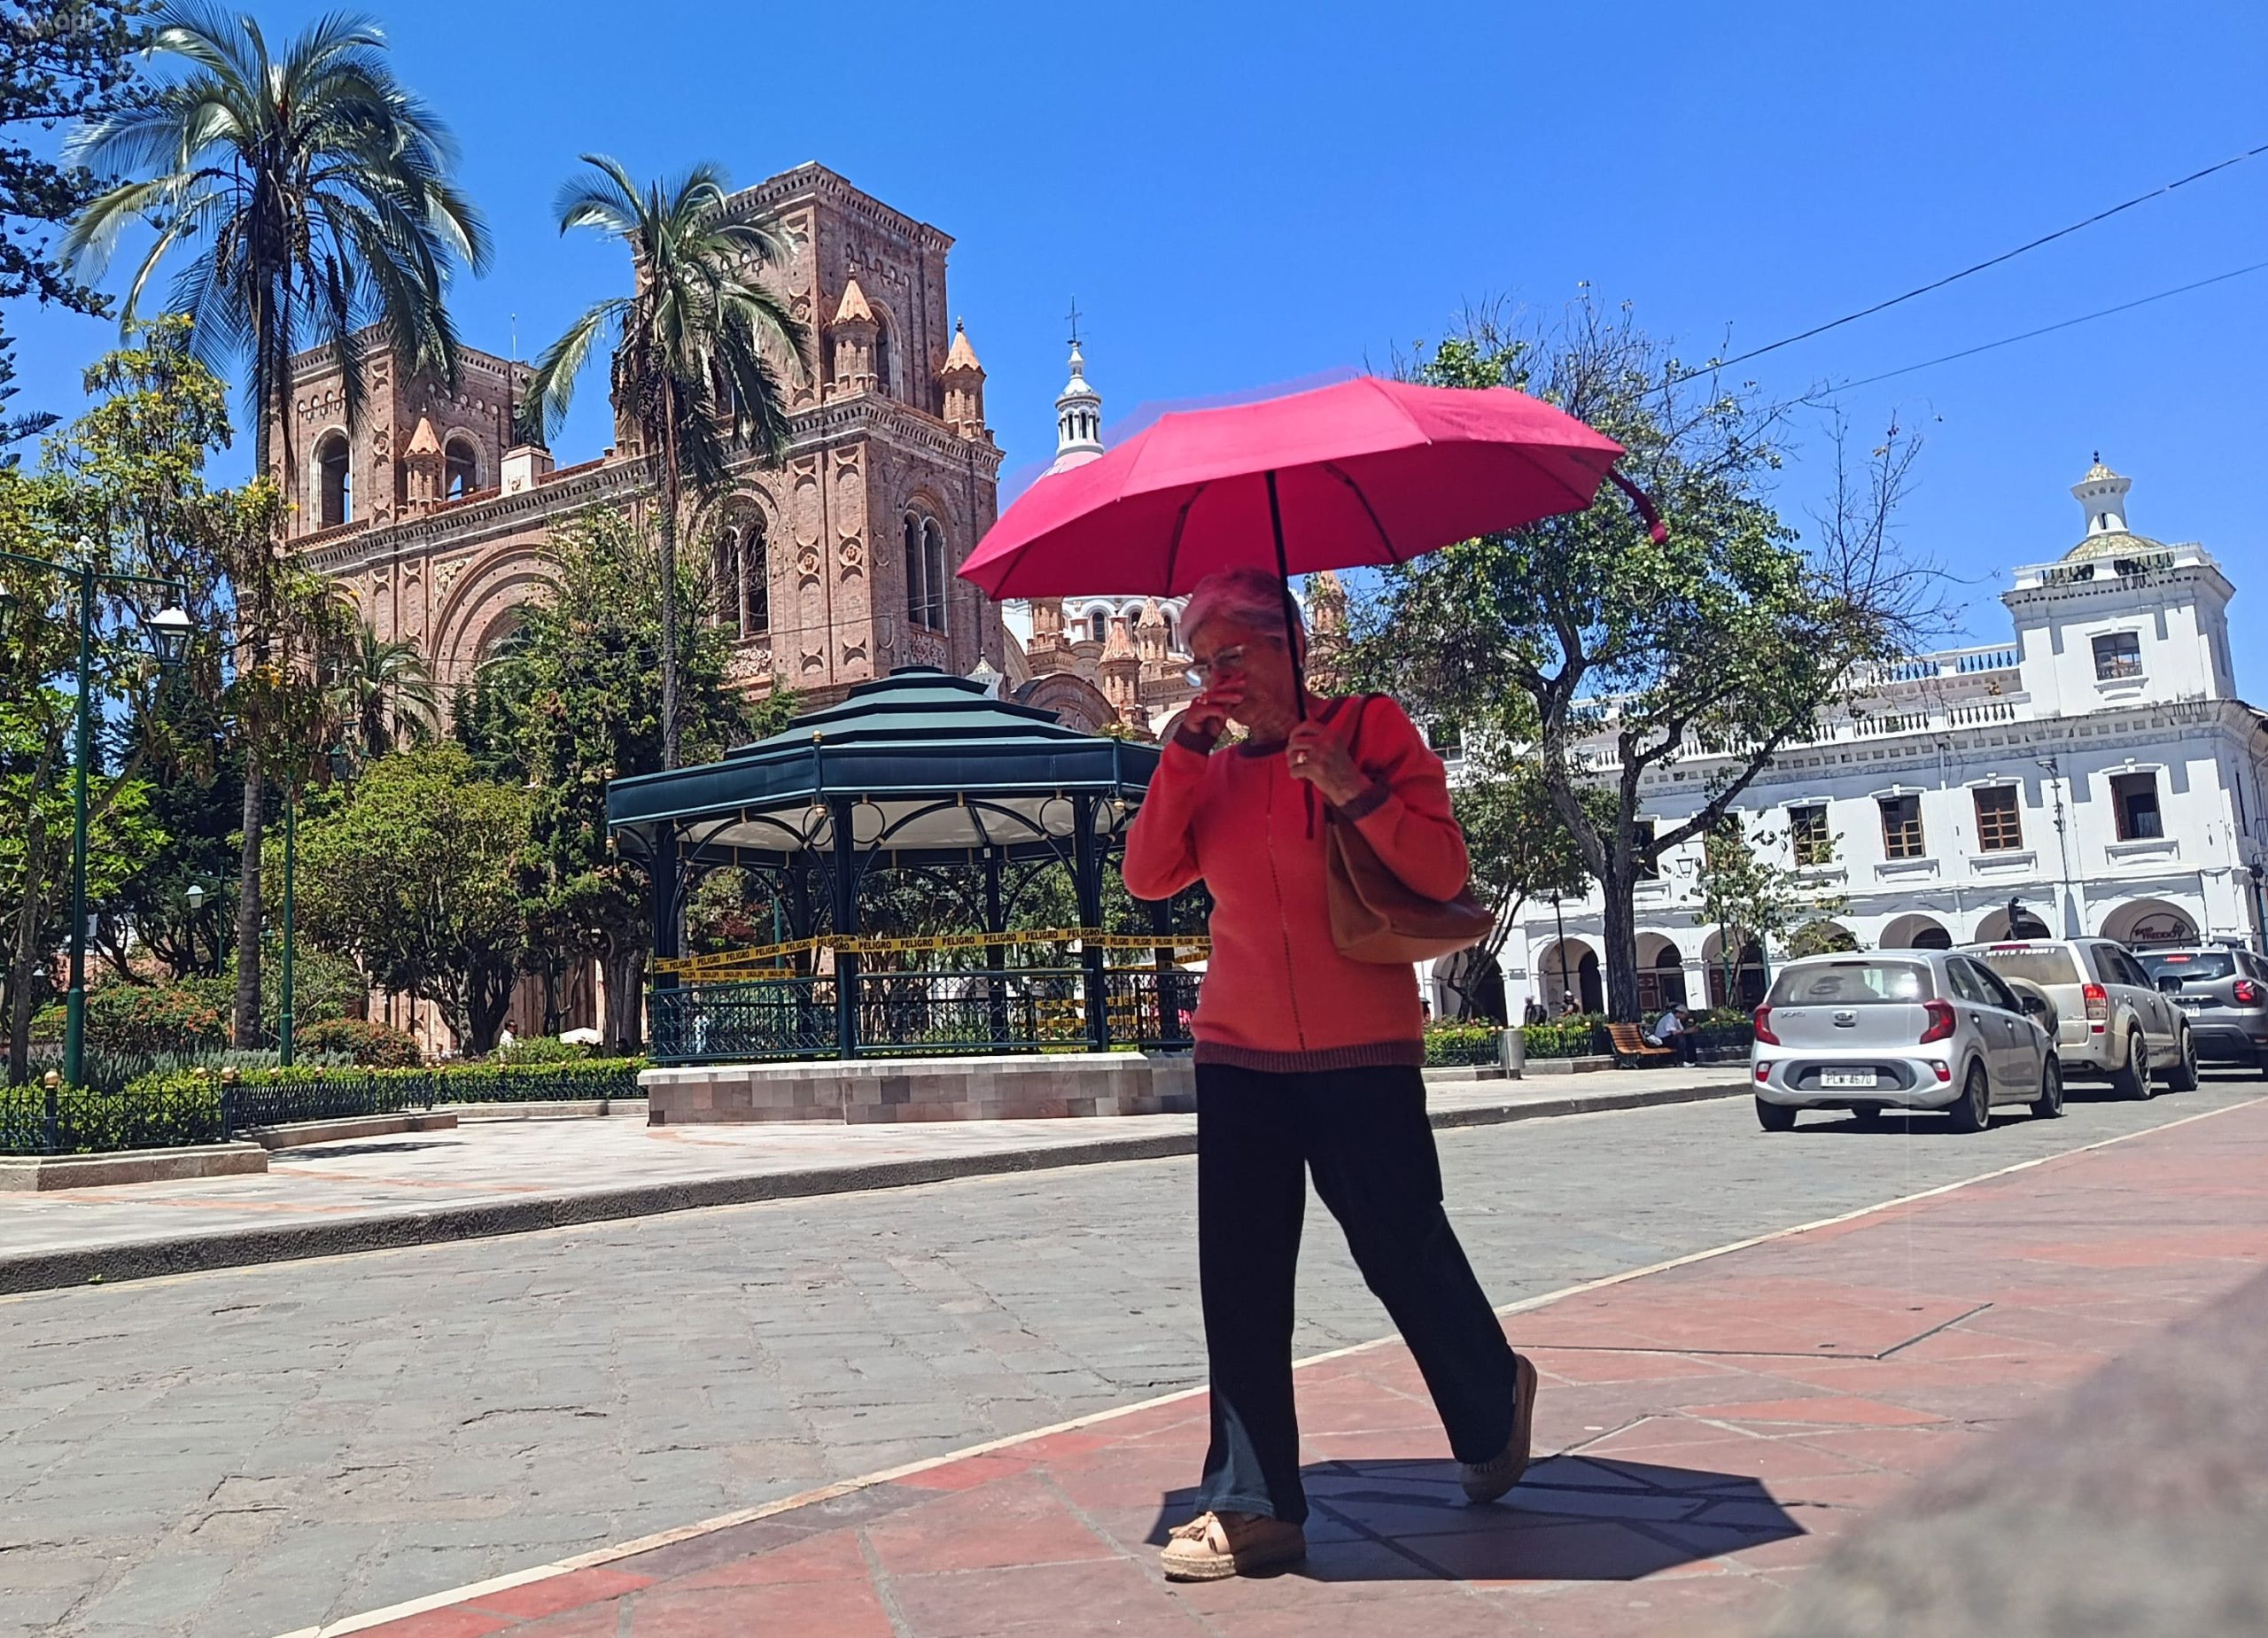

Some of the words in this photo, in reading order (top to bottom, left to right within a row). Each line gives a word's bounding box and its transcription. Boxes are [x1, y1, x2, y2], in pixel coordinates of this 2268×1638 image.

[858, 940, 892, 950] PELIGRO
[900, 938, 934, 948] PELIGRO
[942, 935, 975, 945] PELIGRO
[983, 933, 1017, 943] PELIGRO
[1025, 930, 1059, 940] PELIGRO
[1066, 928, 1099, 938] PELIGRO
[669, 959, 693, 970] PELIGRO
[697, 955, 720, 966] PELIGRO
[726, 951, 750, 962] PELIGRO
[755, 945, 780, 957] PELIGRO
[786, 941, 811, 951] PELIGRO
